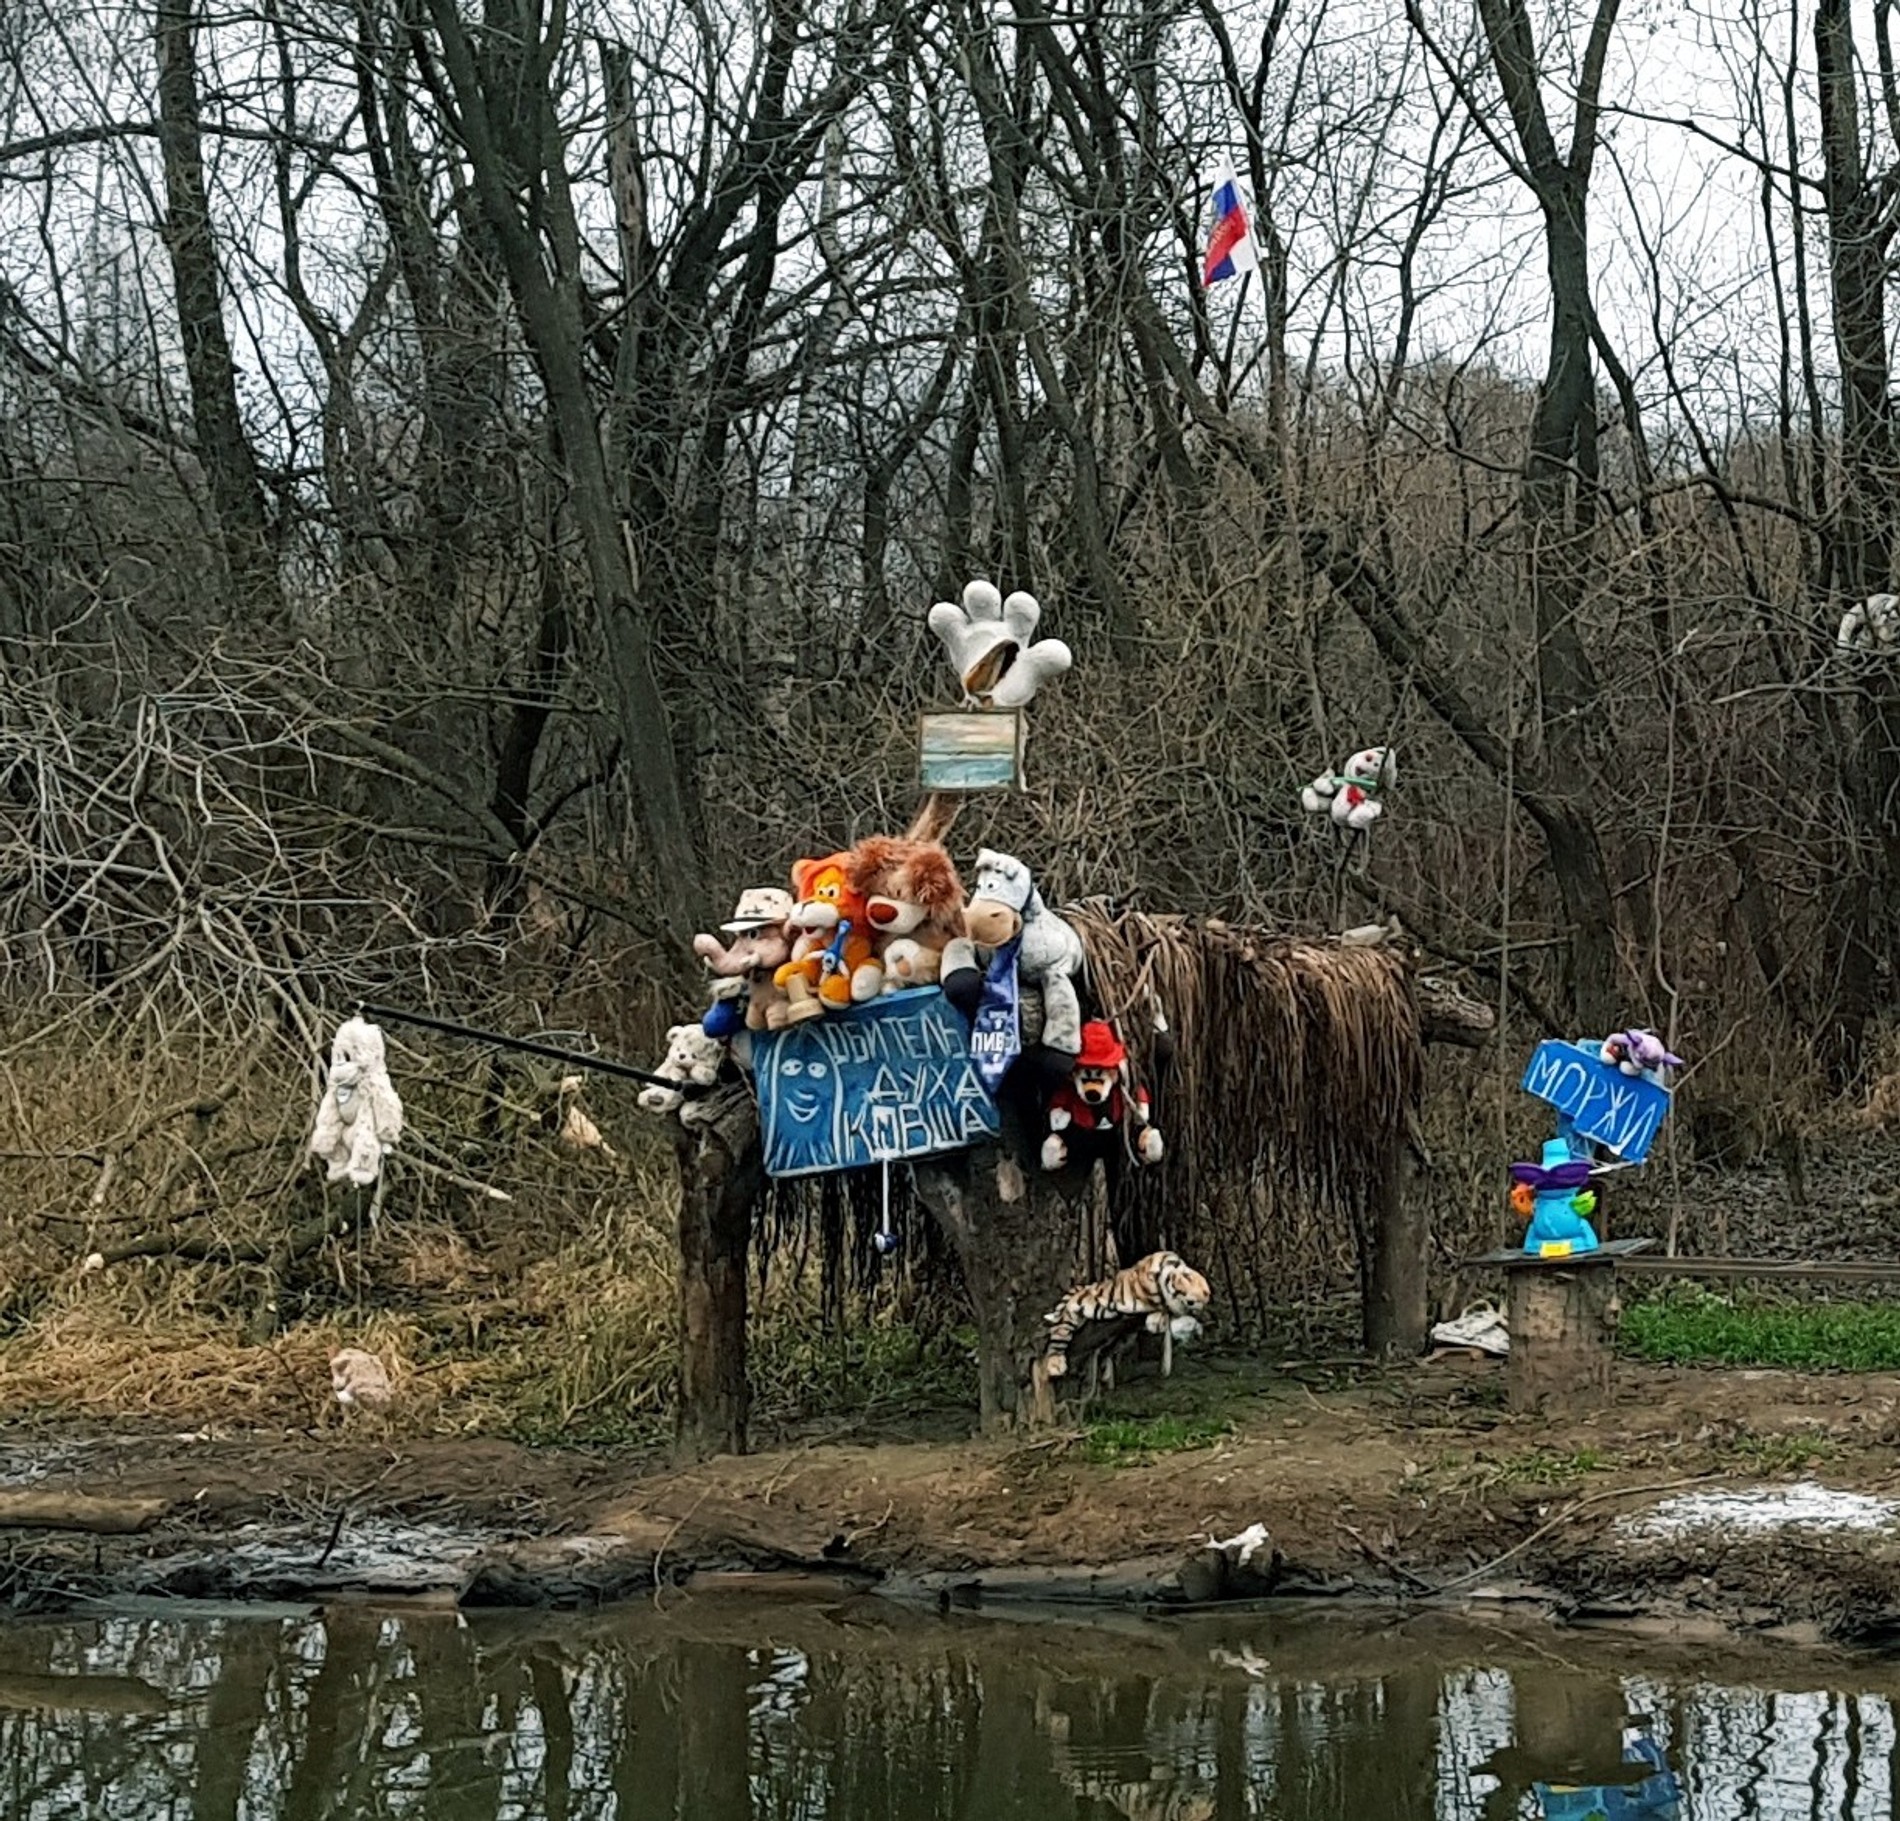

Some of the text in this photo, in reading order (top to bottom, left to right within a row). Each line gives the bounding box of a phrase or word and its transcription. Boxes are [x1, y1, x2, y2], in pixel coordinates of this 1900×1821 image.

[825, 1009, 966, 1064] ОБИТЕЛЬ
[866, 1062, 992, 1107] ДУХА
[1527, 1051, 1657, 1154] МОРЖИ
[843, 1100, 999, 1162] КОВША
